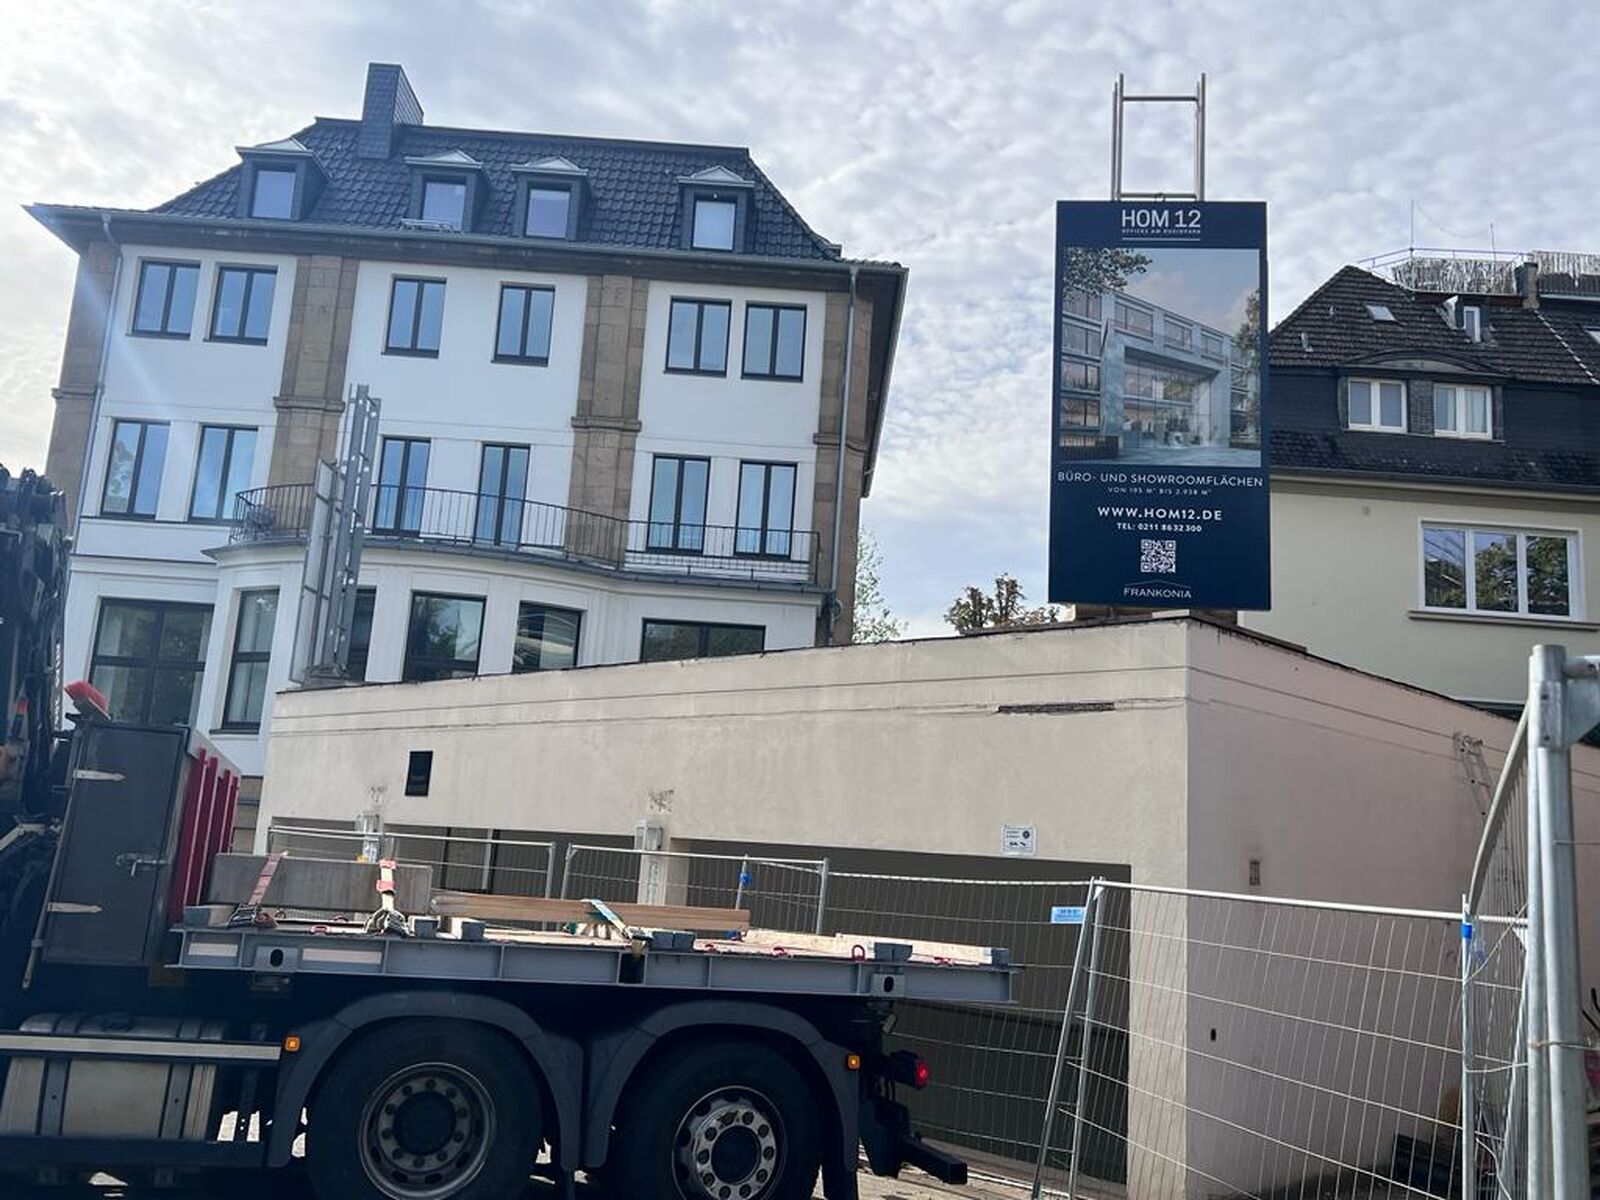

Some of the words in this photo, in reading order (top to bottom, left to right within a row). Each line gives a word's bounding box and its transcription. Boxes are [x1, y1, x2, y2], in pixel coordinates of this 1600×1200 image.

[1121, 209, 1169, 228] HOM
[1174, 209, 1201, 228] 12
[1100, 473, 1128, 483] UND
[1130, 474, 1263, 487] SHOWROOMFLÄCHEN
[1097, 507, 1223, 521] WWW.HOM12.DE
[1137, 523, 1159, 531] 0211
[1123, 587, 1192, 599] FRANKONIA
